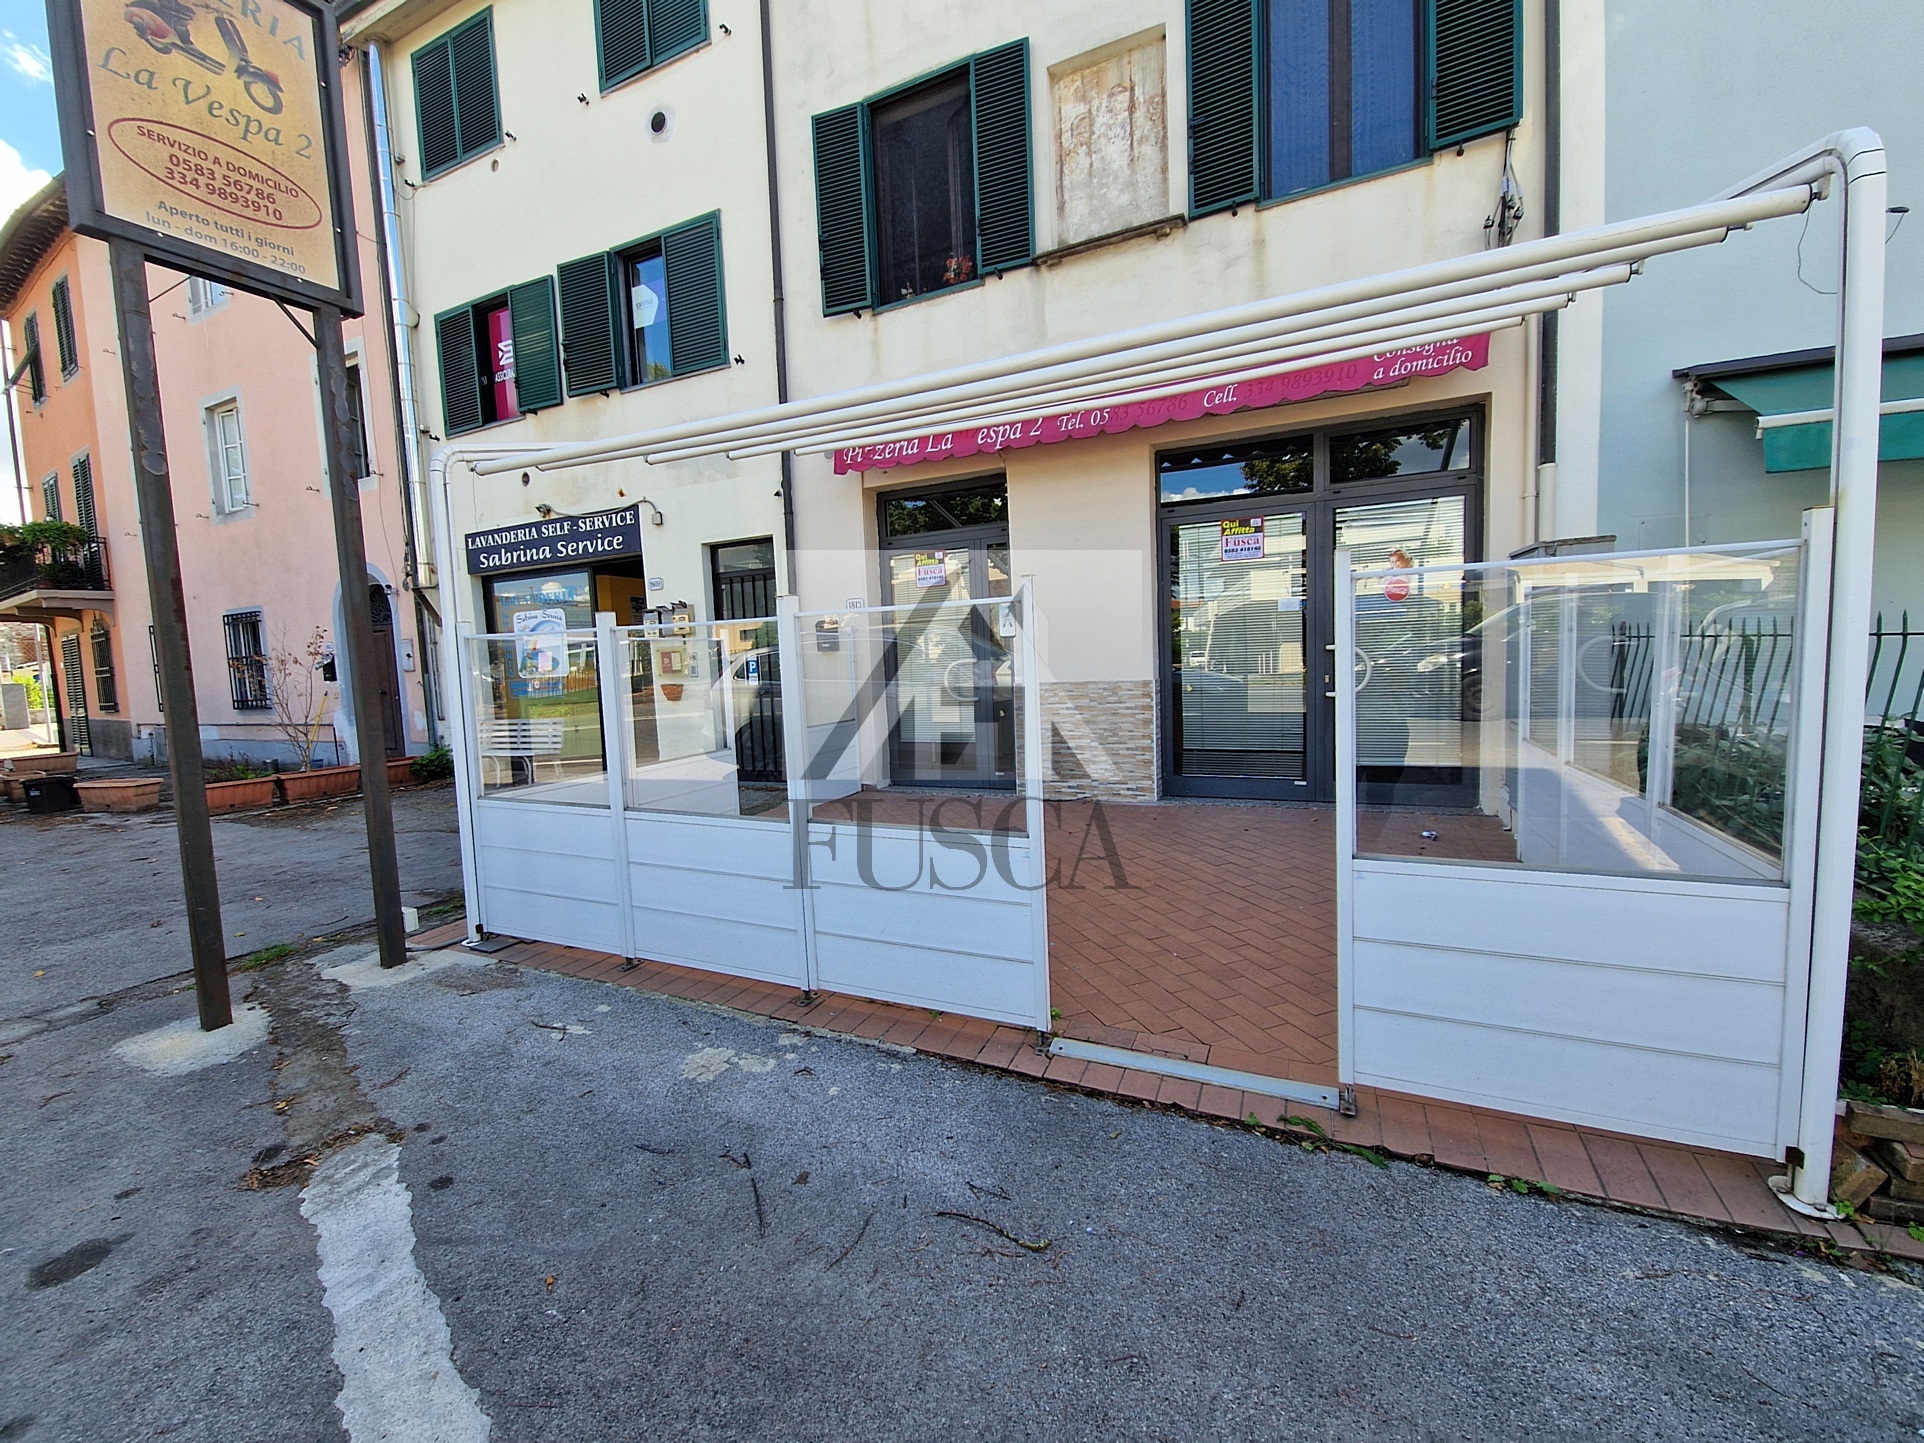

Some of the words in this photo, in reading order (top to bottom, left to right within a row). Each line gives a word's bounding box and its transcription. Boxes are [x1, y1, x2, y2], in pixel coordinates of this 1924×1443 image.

[217, 0, 305, 61] RIA
[97, 47, 159, 91] La
[172, 76, 284, 146] Vespa
[295, 133, 313, 160] 2
[136, 124, 209, 163] SERVIZIO
[212, 152, 223, 167] A
[226, 161, 299, 199] DOMICILIO
[168, 153, 217, 182] 0583
[222, 174, 276, 206] 56786
[164, 166, 201, 192] 334
[206, 182, 284, 222] 9893910
[146, 211, 172, 231] lun
[184, 225, 218, 246] dom
[221, 237, 260, 260] 16:00
[270, 256, 306, 275] 22:00
[157, 200, 211, 228] Aperto
[214, 220, 245, 240] tutti
[247, 229, 252, 242] i
[255, 232, 295, 257] giorni
[1373, 367, 1385, 380] a
[1389, 346, 1473, 376] domicilio
[925, 432, 954, 453] La
[977, 421, 1023, 450] espa
[1029, 417, 1043, 437] 2
[1057, 409, 1084, 432] Tel.
[1203, 383, 1237, 408] Cell.
[467, 527, 539, 549] LAVANDERIA
[1222, 520, 1239, 528] Qui
[1223, 526, 1255, 536] Affitta
[1225, 537, 1260, 547] Fusca
[479, 545, 552, 568] Sabrina
[557, 534, 624, 557] Service
[915, 552, 928, 561] Qui
[918, 567, 943, 577] Fusca
